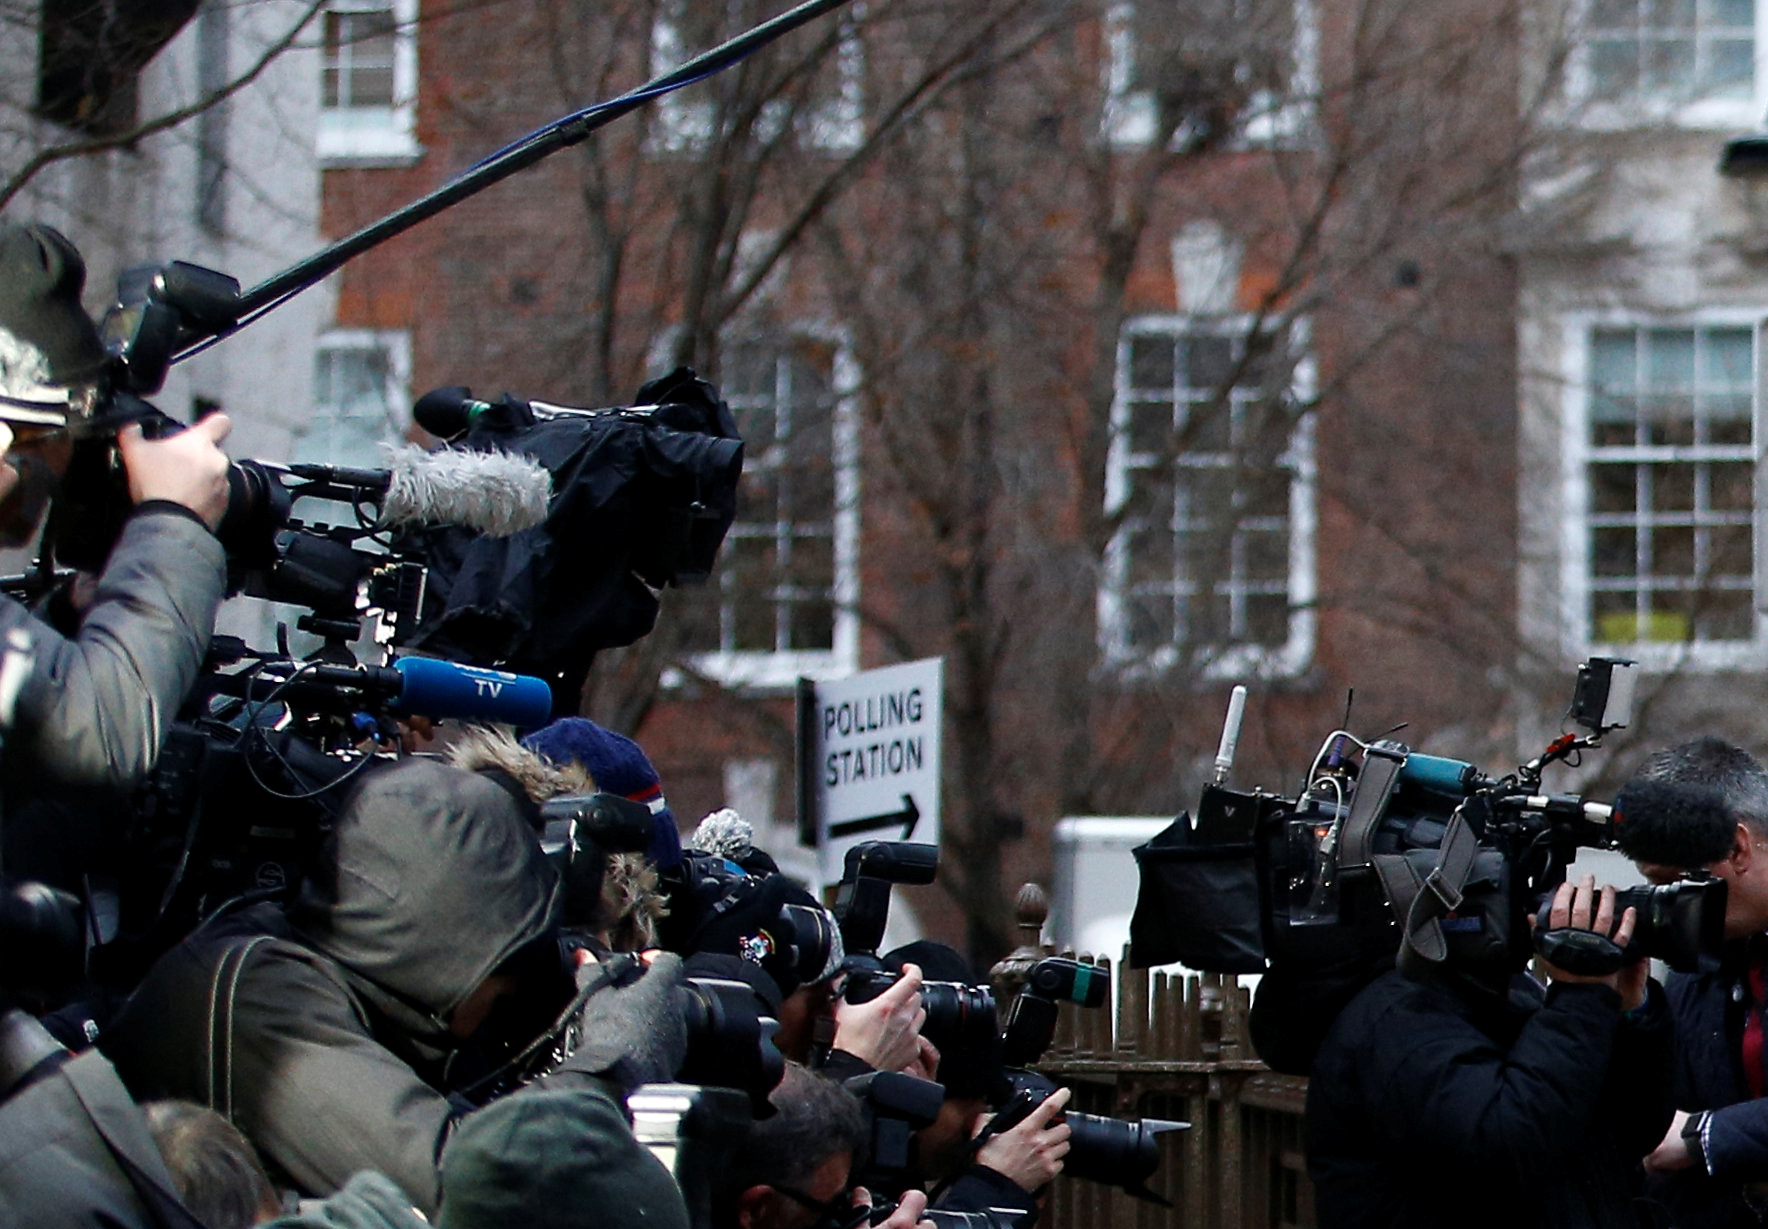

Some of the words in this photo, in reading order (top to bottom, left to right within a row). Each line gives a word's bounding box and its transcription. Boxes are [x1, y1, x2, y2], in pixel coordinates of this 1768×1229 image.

[473, 679, 503, 700] TV
[824, 687, 922, 740] POLLING
[826, 736, 923, 788] STATION
